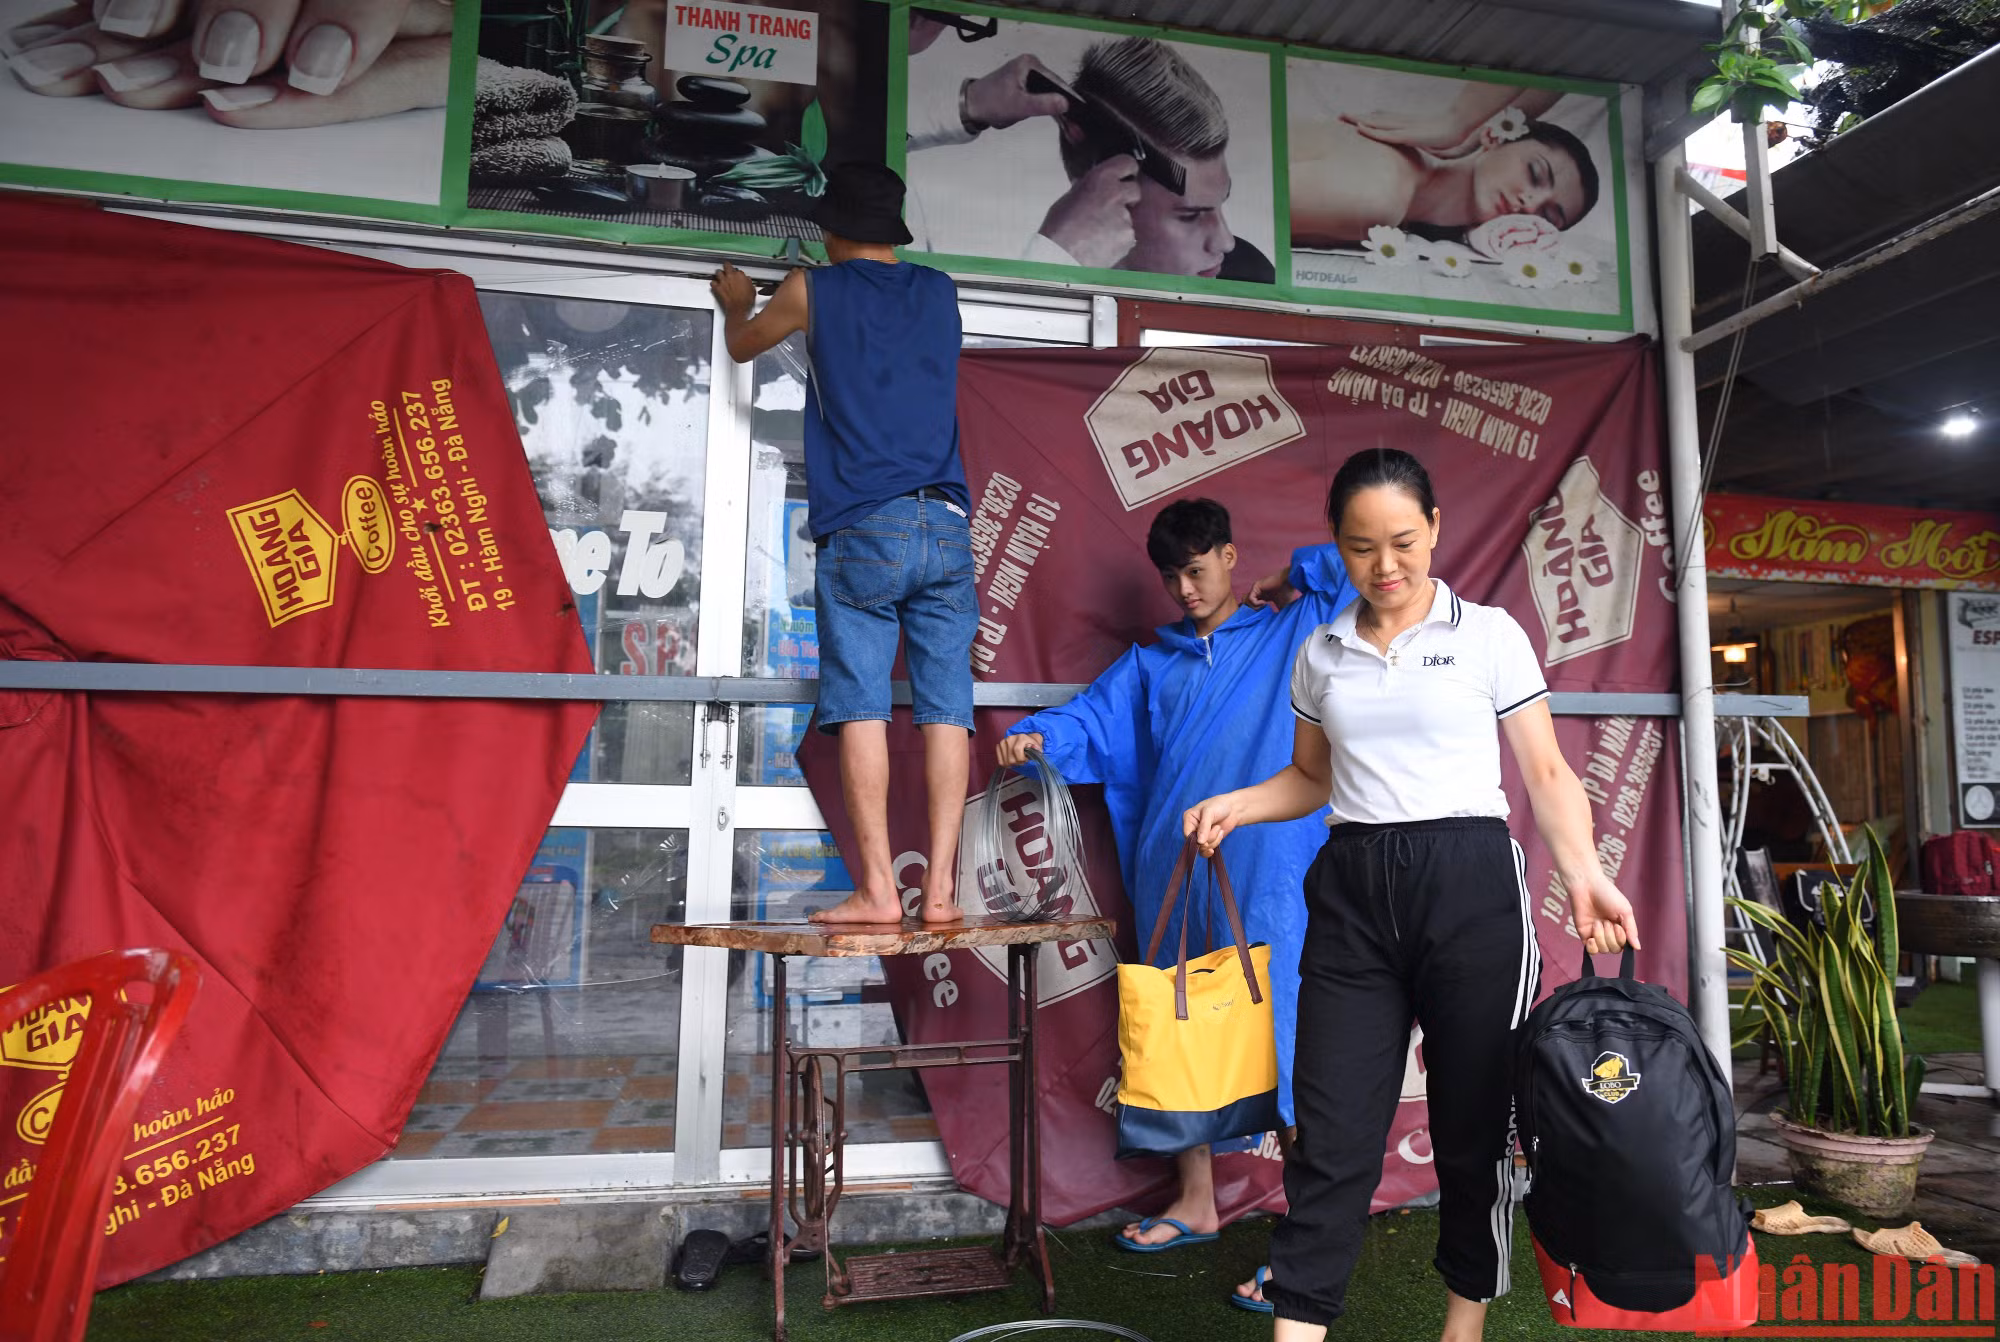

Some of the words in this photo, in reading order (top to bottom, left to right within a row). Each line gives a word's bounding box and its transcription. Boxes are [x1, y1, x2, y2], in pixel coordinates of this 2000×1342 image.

[675, 5, 741, 33] THANH
[747, 13, 811, 40] TRANG
[705, 33, 778, 73] Spa
[431, 378, 459, 431] Nẵng
[1138, 369, 1215, 414] GIA
[1408, 391, 1429, 418] TP
[369, 400, 391, 434] hảo
[1121, 394, 1281, 480] HOÀNG
[1440, 397, 1484, 440] NGHI
[382, 436, 401, 481] hoàn
[443, 434, 469, 462] Đà
[1516, 429, 1540, 461] 19
[391, 483, 411, 505] sự
[401, 391, 469, 556] 02363.656.237
[461, 477, 488, 523] Nghi
[1025, 493, 1061, 522] 19
[355, 486, 385, 563] Coffee
[399, 510, 421, 542] cho
[1004, 515, 1051, 567] HÀM
[248, 507, 304, 611] HOÀNG
[287, 518, 322, 581] GIA
[405, 545, 435, 582] đầu
[477, 527, 504, 573] Hàm
[616, 509, 685, 599] To
[1577, 514, 1615, 588] GIA
[419, 585, 449, 627] Khởi
[459, 579, 489, 611] ĐT
[493, 588, 515, 611] 19
[987, 557, 1029, 610] NGHI
[620, 621, 699, 677] SP
[977, 615, 1008, 645] TP
[1540, 896, 1564, 924] 19
[26, 1012, 85, 1053] GIA
[4, 1158, 37, 1190] đầ
[133, 1106, 192, 1143] hoàn
[196, 1087, 235, 1117] hảo
[113, 1123, 241, 1196] 3.656.237
[104, 1199, 141, 1236] ghi
[160, 1178, 194, 1207] Đà
[197, 1152, 256, 1191] Nẵng
